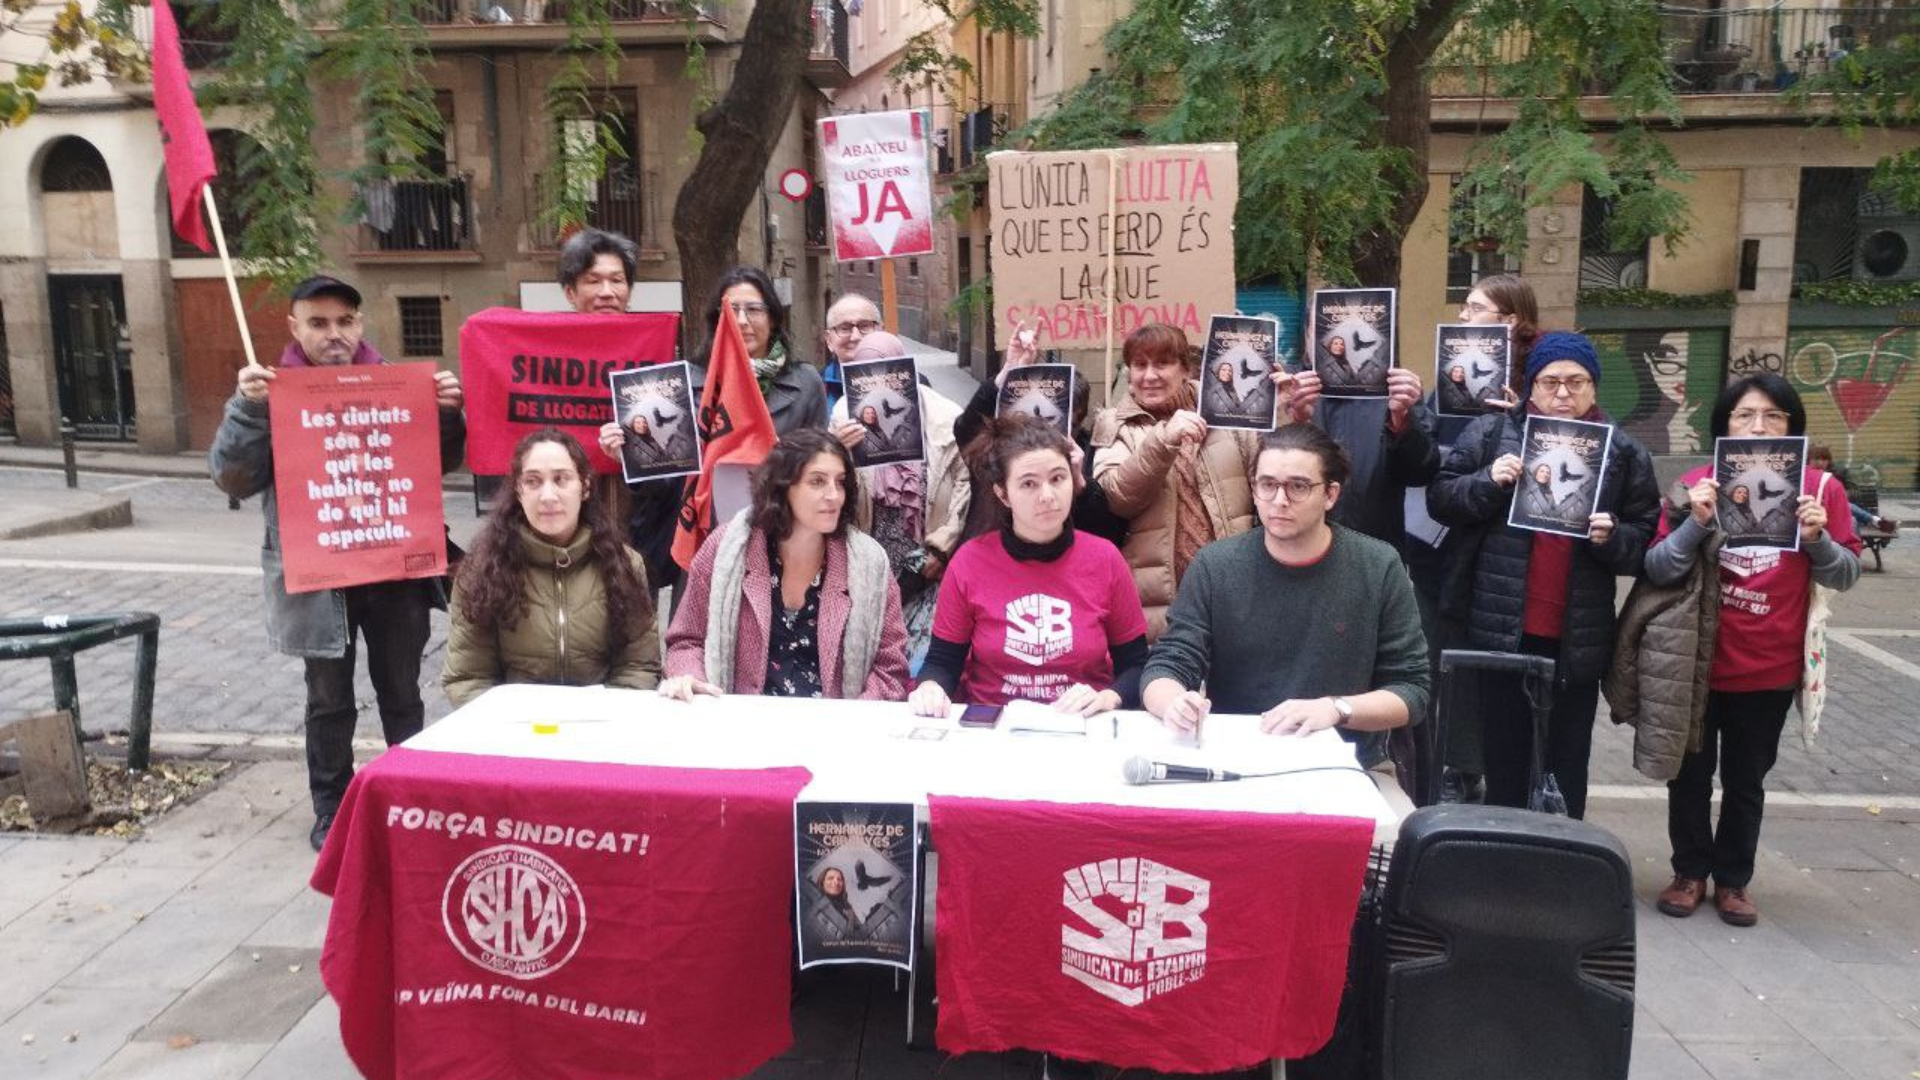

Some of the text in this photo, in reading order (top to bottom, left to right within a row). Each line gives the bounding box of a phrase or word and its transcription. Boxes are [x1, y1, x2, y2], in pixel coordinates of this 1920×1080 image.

[841, 142, 907, 158] ABAIXEU
[844, 166, 910, 181] LLOGUERS
[1000, 158, 1090, 210] L'ÚNICA
[851, 180, 914, 226] JA
[1001, 218, 1052, 259] QUE
[1061, 217, 1090, 252] ES
[1178, 204, 1211, 253] ÉS
[1060, 263, 1161, 303] LA QUE
[301, 406, 412, 428] Les ciutats
[515, 400, 539, 418] DE
[323, 429, 392, 451] són de
[325, 452, 394, 478] qui les
[307, 477, 414, 500] habita, no
[318, 496, 408, 524] de qui hi
[318, 521, 413, 550] especula.
[387, 805, 650, 857] FORÇA SINDICAT!
[885, 824, 905, 838] DE
[463, 851, 512, 882] SINDICAT
[1062, 946, 1125, 984] SINDICAT
[1123, 966, 1144, 984] DE
[1146, 966, 1206, 1001] POBLE-SEC
[418, 982, 484, 1006] VEÏNA
[489, 985, 540, 1007] FORA
[545, 994, 580, 1016] DEL
[583, 1002, 648, 1026] BARRI
